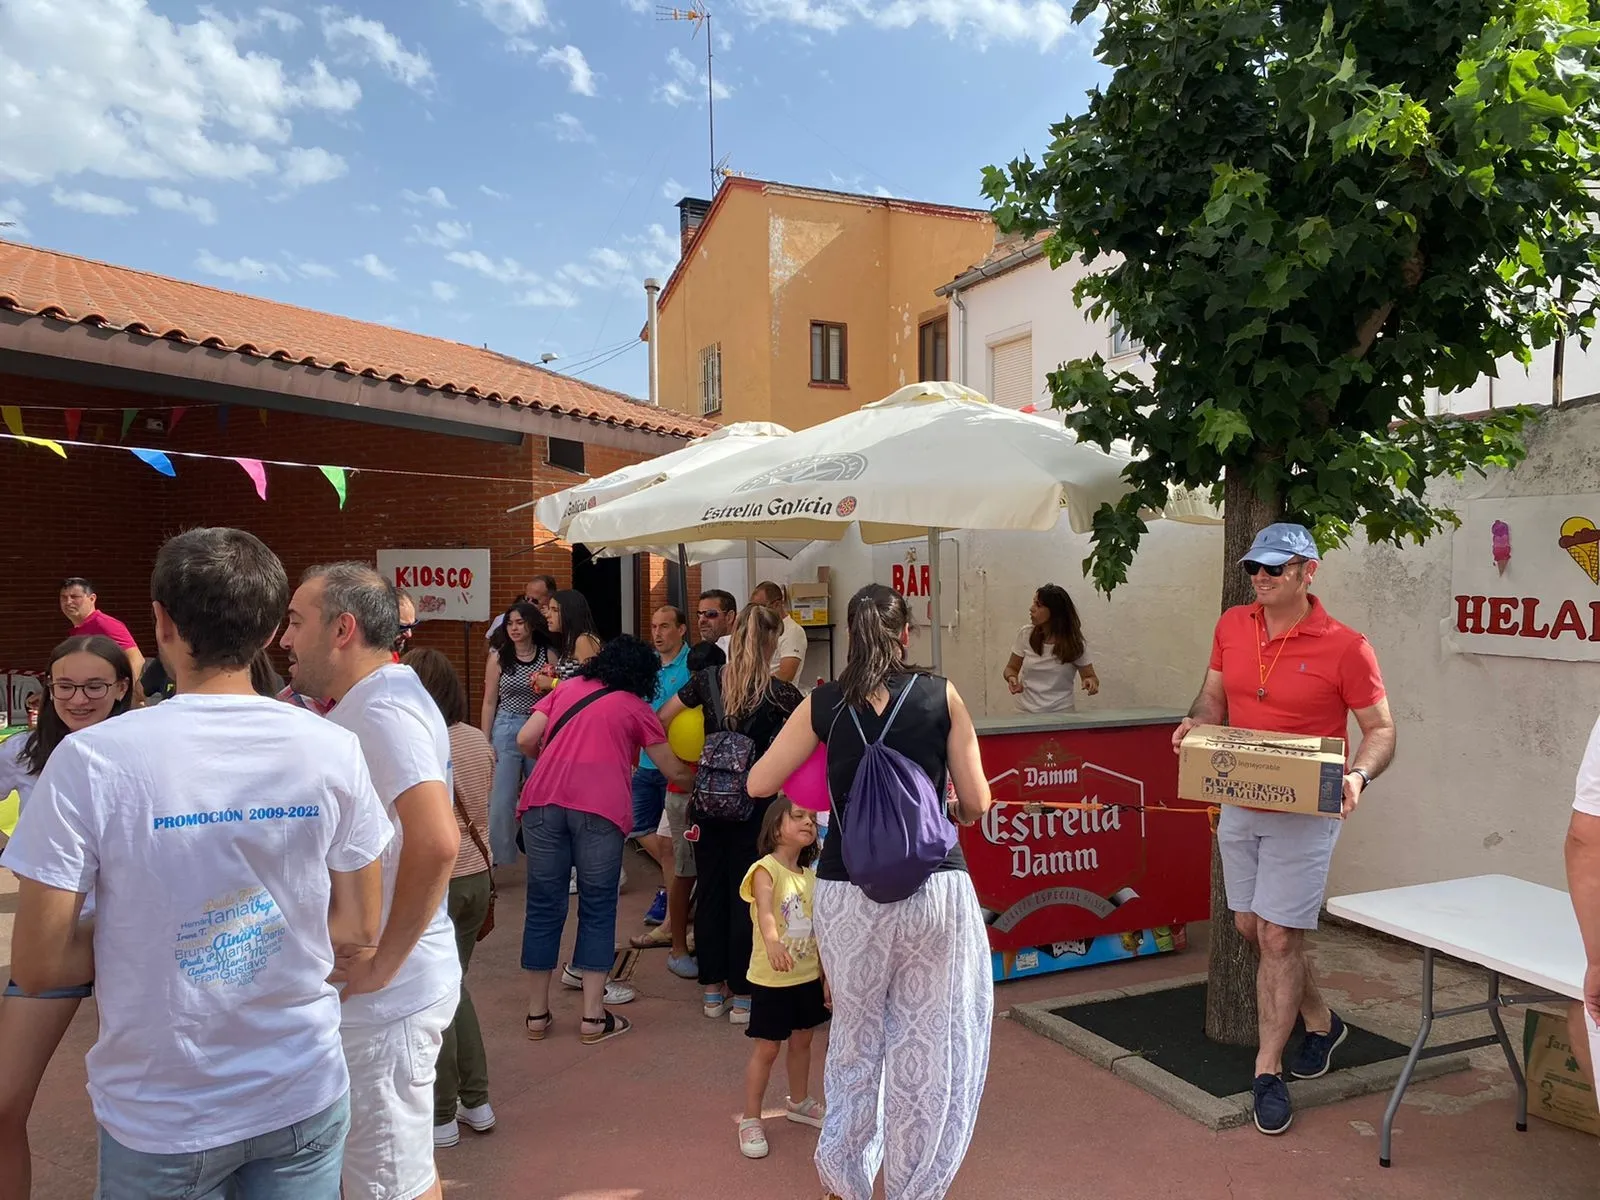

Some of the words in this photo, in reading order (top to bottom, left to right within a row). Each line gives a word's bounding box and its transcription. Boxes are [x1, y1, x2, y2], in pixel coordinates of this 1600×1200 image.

[701, 503, 763, 521] Estrella
[767, 497, 833, 516] Galicia
[395, 566, 472, 589] KIOSCO
[892, 565, 931, 597] BAR
[1205, 742, 1317, 758] MONDARIZ
[1024, 767, 1078, 787] Damm
[154, 808, 243, 829] PROMOCIÓN
[249, 805, 320, 820] 2009-2022
[1008, 845, 1099, 878] Damm
[1035, 890, 1080, 904] ESPECIAL
[203, 902, 250, 925] Tania
[213, 927, 261, 951] Ainara
[175, 945, 213, 960] Bruno
[220, 956, 268, 979] Gustavo
